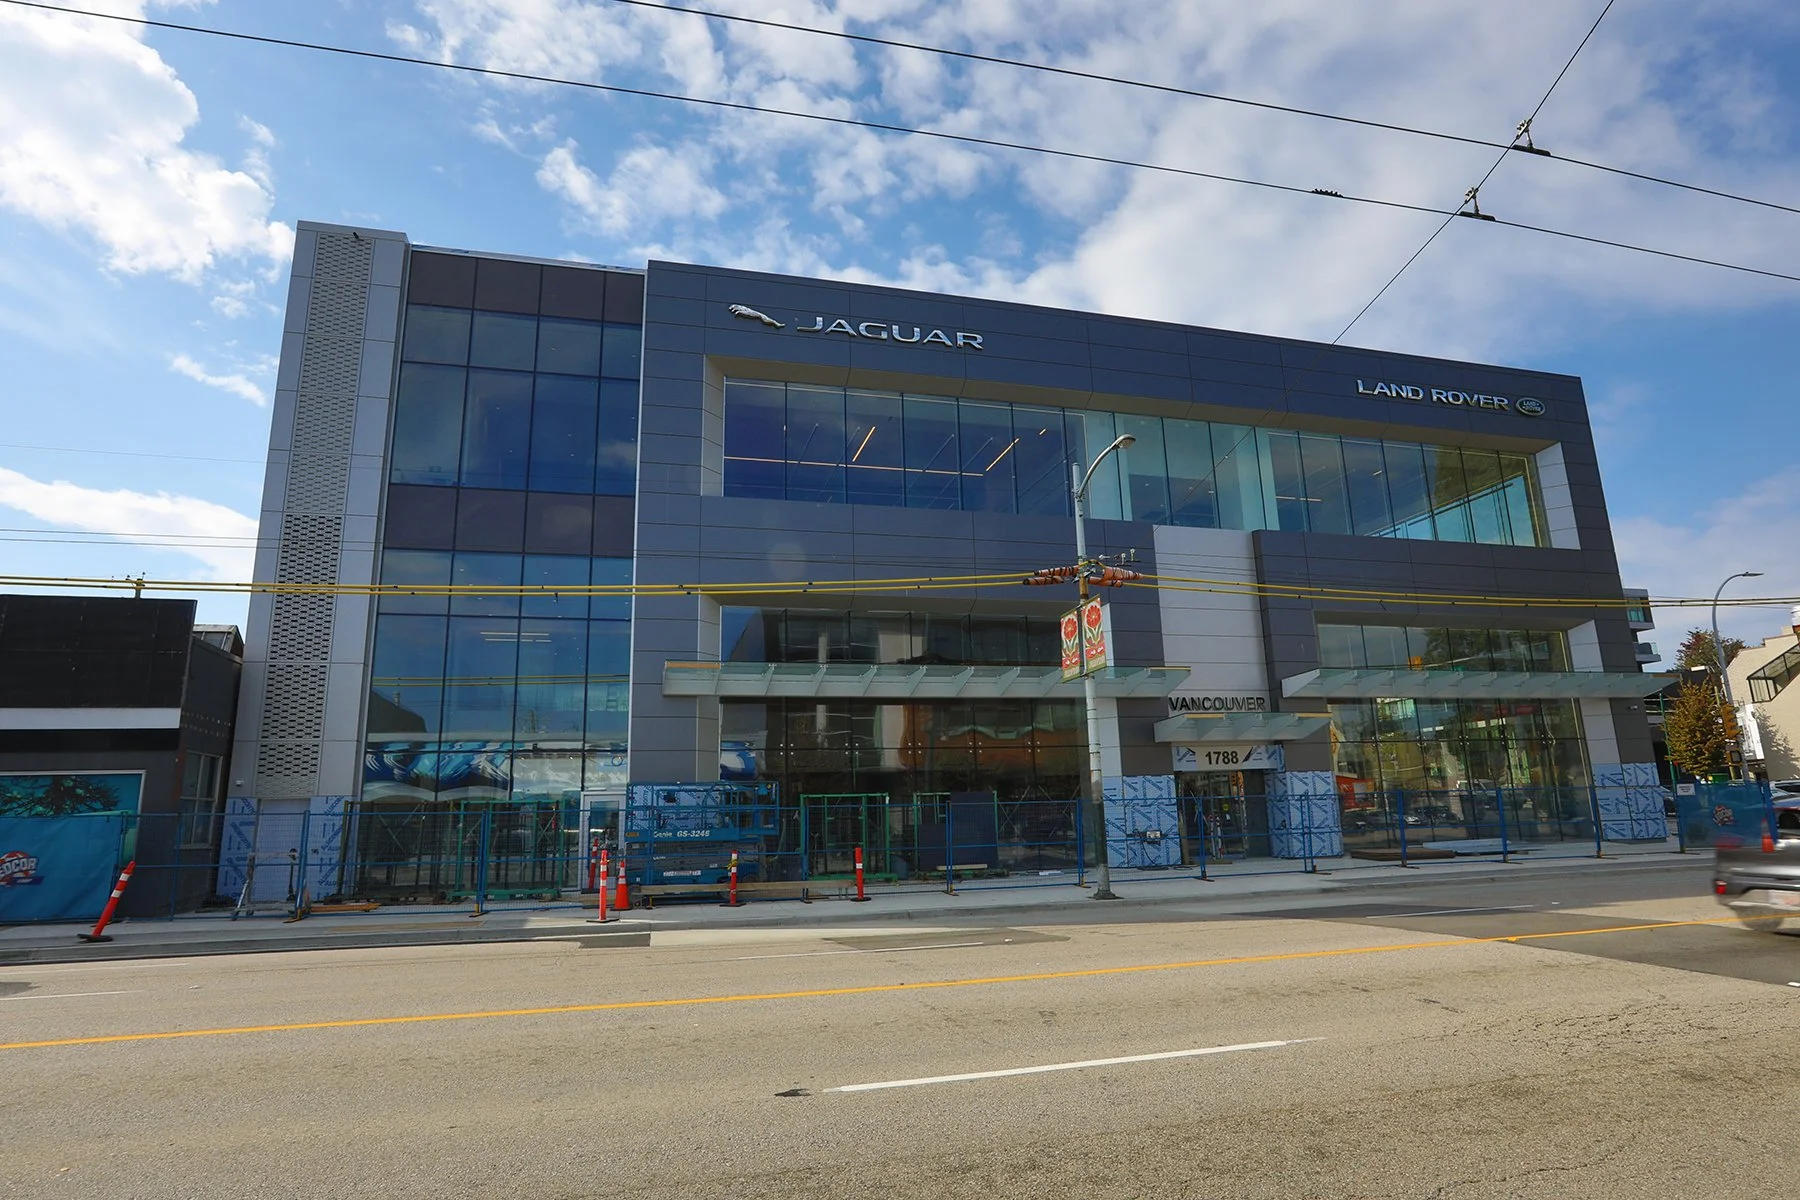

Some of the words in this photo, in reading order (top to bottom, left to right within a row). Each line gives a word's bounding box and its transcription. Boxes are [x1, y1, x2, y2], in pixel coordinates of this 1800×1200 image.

[797, 316, 984, 350] JAGUAR
[1356, 379, 1424, 401] LAND
[1431, 387, 1510, 411] ROVER
[1168, 696, 1266, 711] VANCOUVER
[1205, 751, 1239, 765] 1788
